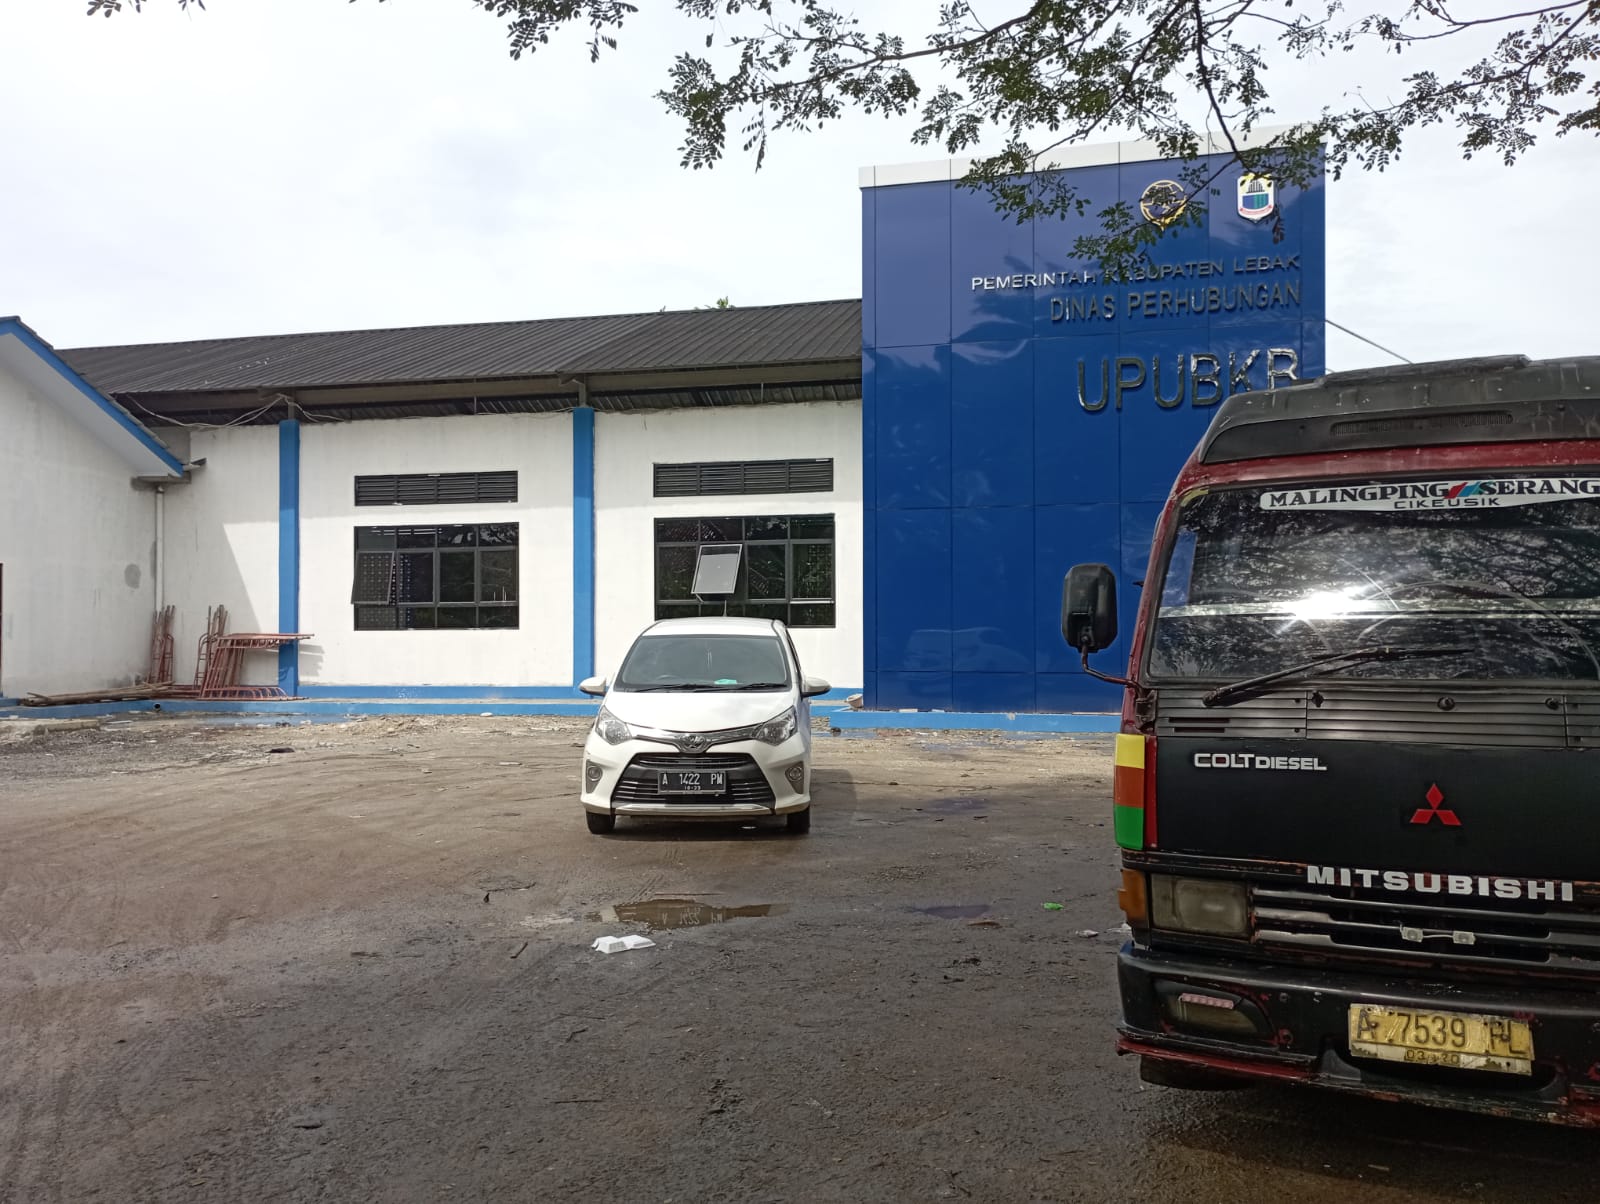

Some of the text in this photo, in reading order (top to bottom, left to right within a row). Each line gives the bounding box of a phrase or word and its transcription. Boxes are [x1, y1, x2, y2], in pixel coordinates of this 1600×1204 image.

[971, 270, 1097, 291] PEMERINTAH
[1233, 254, 1300, 274] LEBAK
[1050, 280, 1301, 322] DINAS PERHUBUNGAN
[1077, 347, 1299, 412] UPUBKR
[1269, 479, 1600, 508] MALINGPING SERANG
[1393, 497, 1502, 510] CIKEUSIK
[679, 773, 701, 785] 1422
[1307, 865, 1574, 902] MITSUBISHI
[1358, 1008, 1376, 1040] A
[1397, 1011, 1467, 1049] 7539
